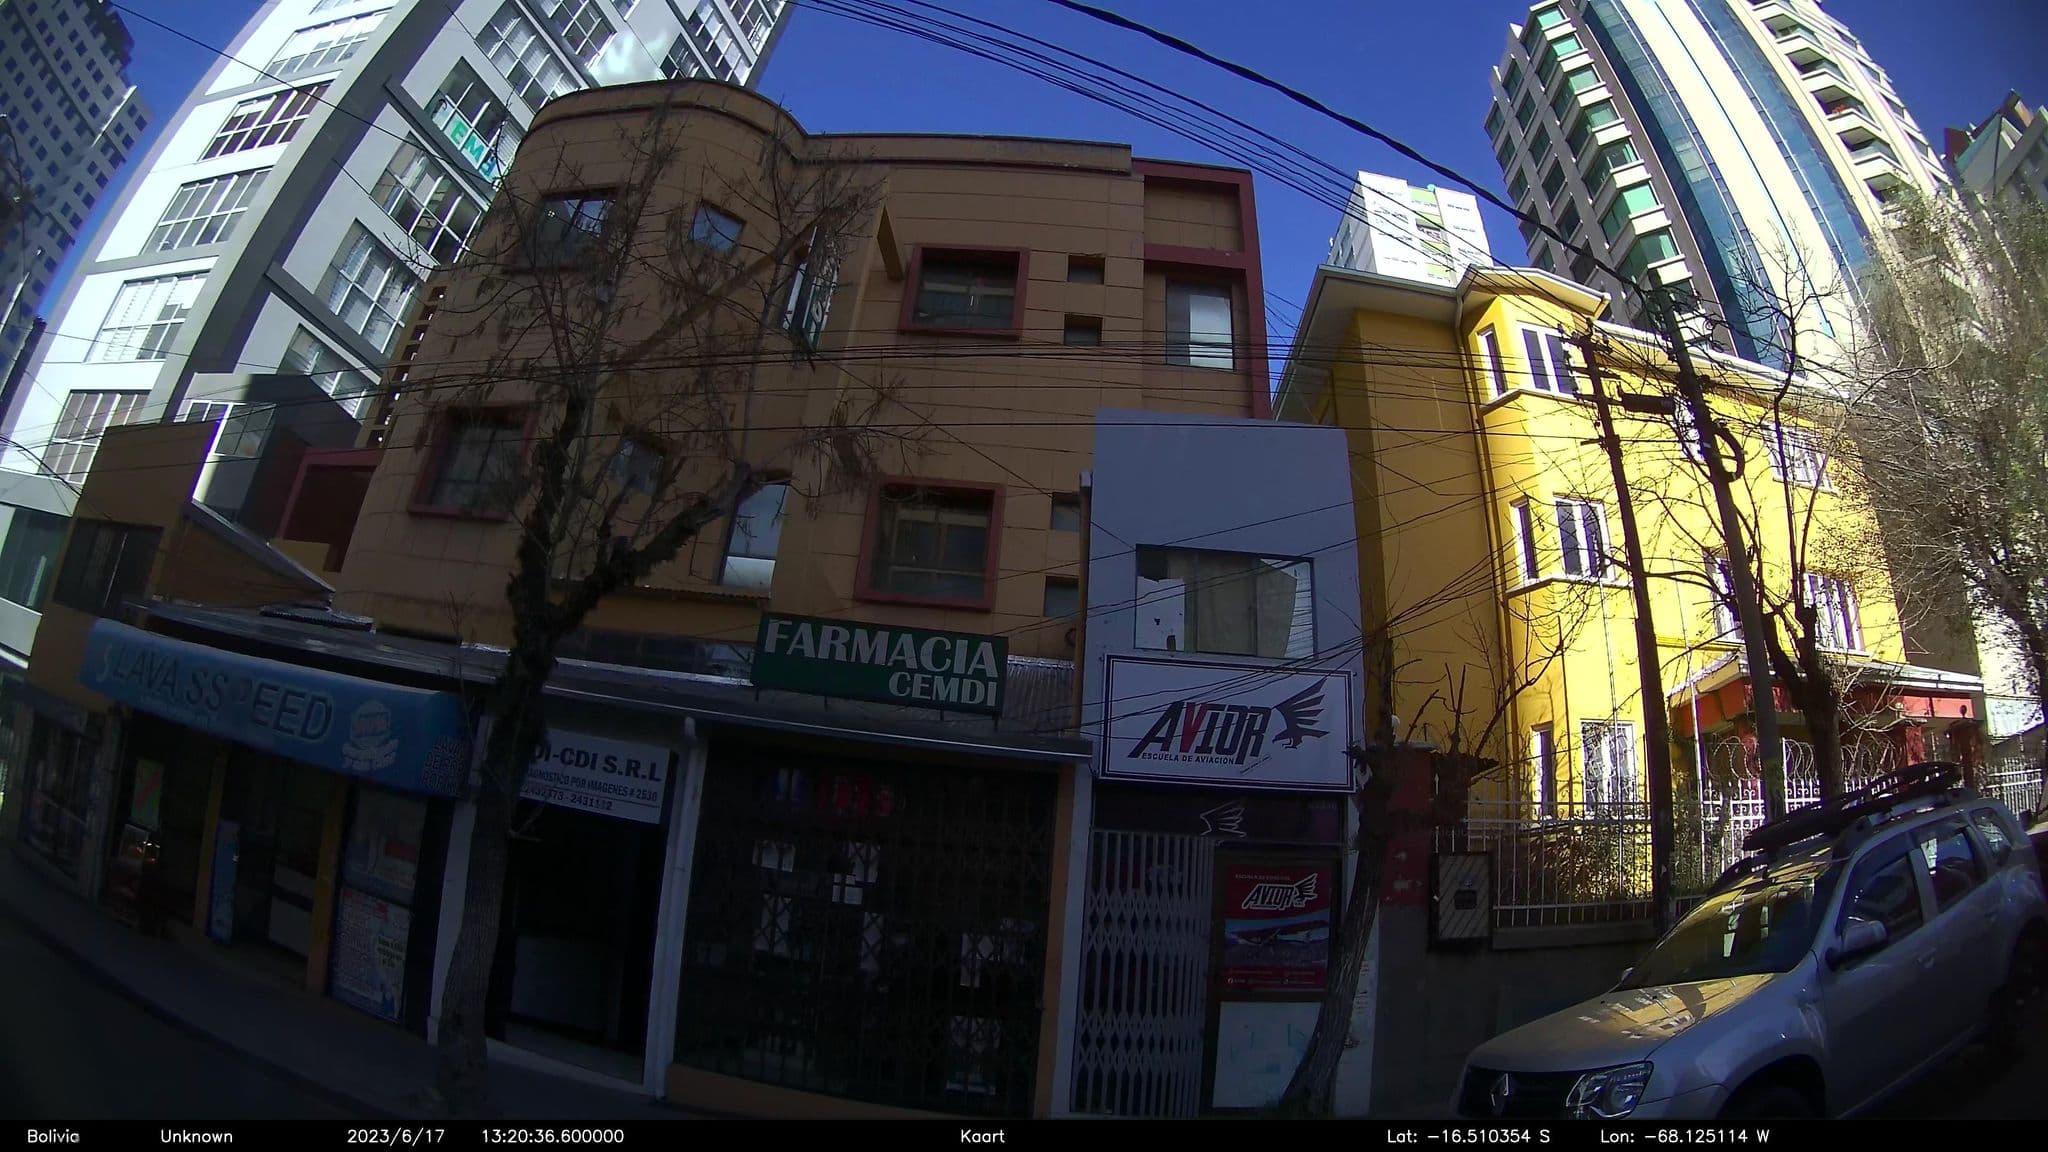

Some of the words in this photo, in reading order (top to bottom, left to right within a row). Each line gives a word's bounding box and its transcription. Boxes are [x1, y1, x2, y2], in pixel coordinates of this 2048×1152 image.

[764, 619, 998, 678] FARMACIA
[888, 671, 997, 707] CEMDI
[1128, 701, 1273, 765] AVIOR
[1141, 752, 1179, 762] ESCUELA
[588, 779, 628, 797] IMAGENES
[1241, 883, 1296, 911] AVIOR
